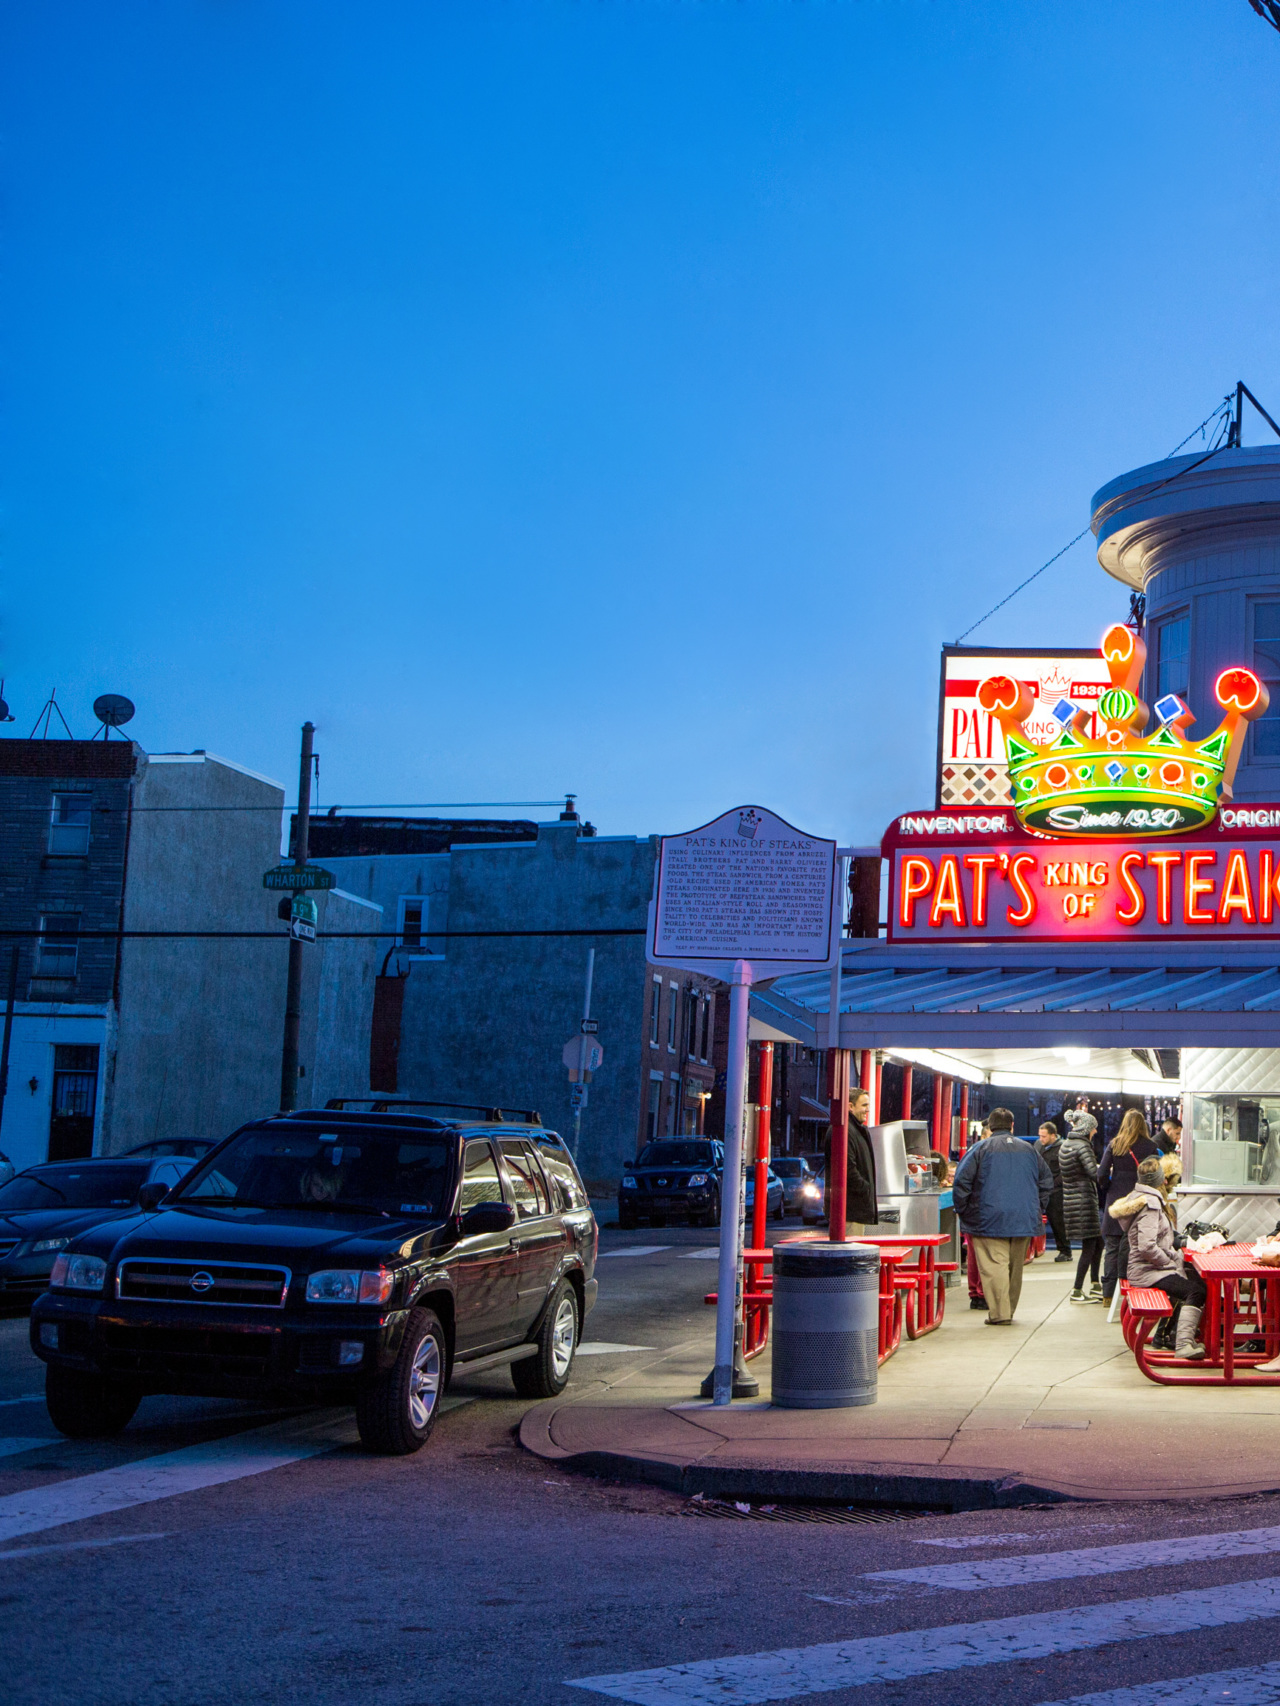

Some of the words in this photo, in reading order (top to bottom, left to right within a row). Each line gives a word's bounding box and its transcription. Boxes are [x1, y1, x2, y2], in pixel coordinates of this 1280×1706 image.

[1072, 685, 1106, 696] 1930
[949, 707, 1000, 759] PAT
[1022, 721, 1055, 734] KING
[900, 816, 1005, 834] INVENTOR
[1049, 805, 1120, 830] Since
[1122, 808, 1181, 828] 1930
[720, 838, 747, 848] KING
[751, 840, 765, 848] OF
[266, 874, 315, 887] WHARTON
[320, 878, 329, 887] ST
[900, 850, 1037, 927] PAT'S
[1046, 861, 1108, 886] KING
[1062, 893, 1096, 918] OF
